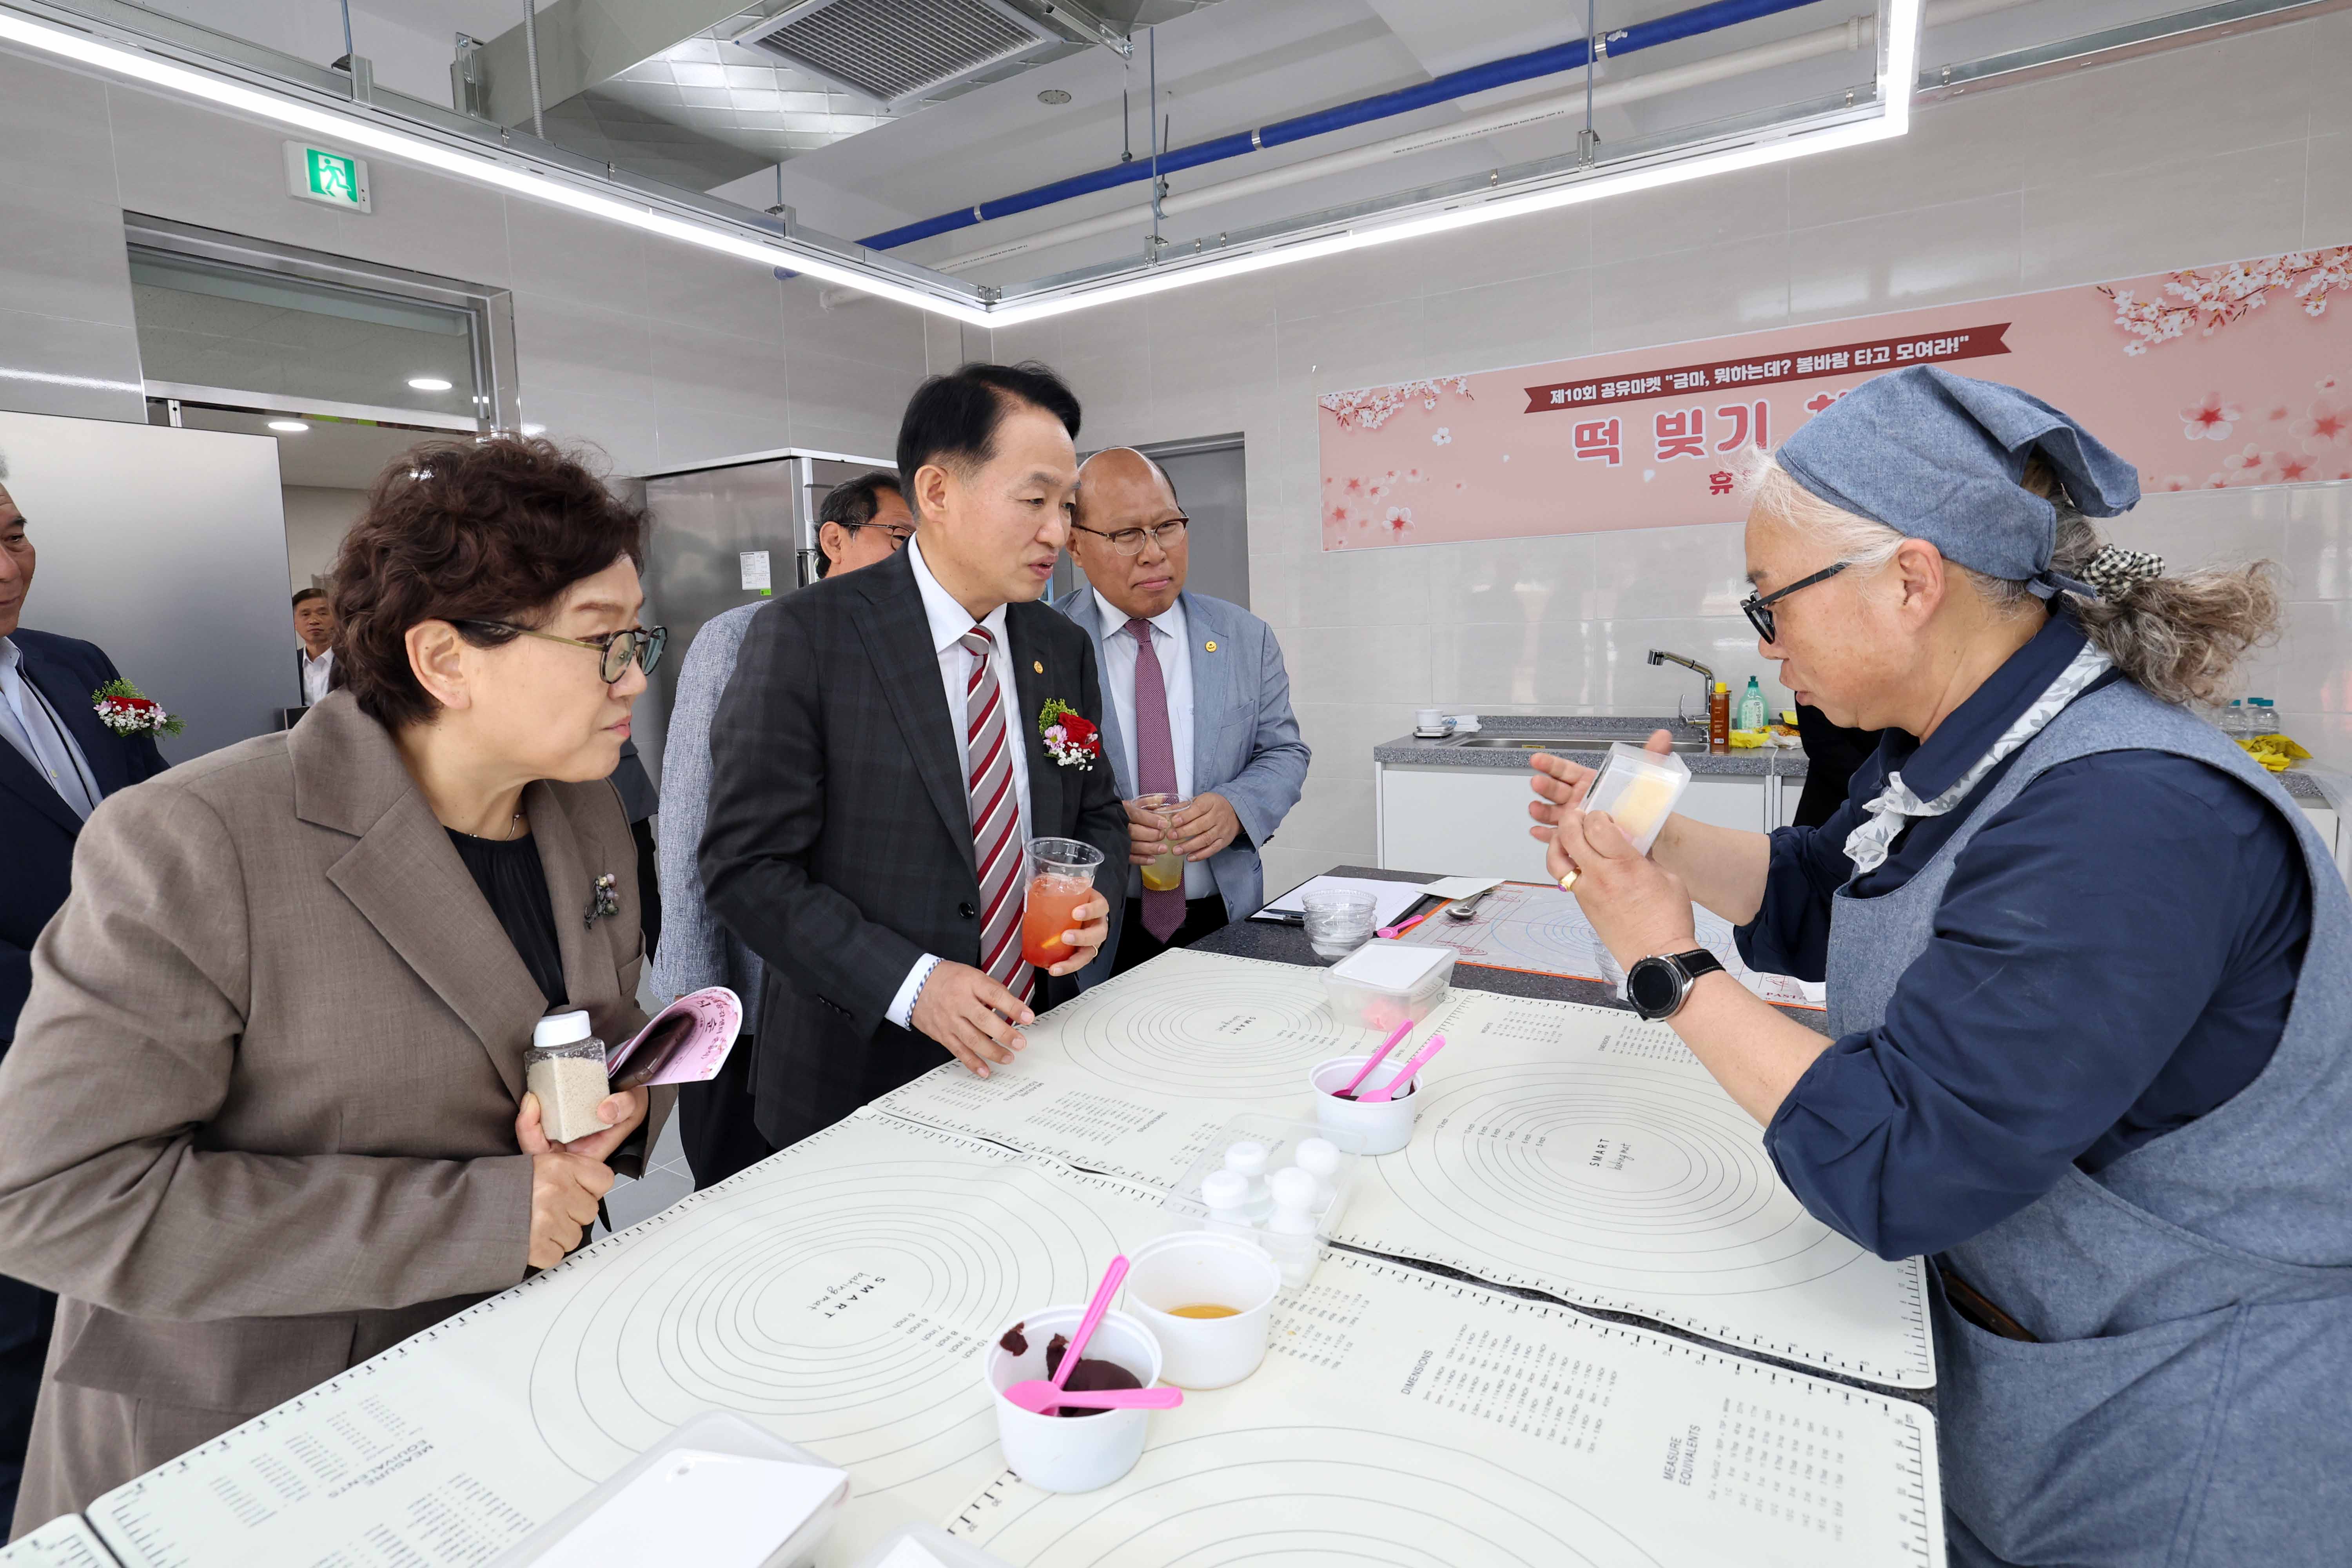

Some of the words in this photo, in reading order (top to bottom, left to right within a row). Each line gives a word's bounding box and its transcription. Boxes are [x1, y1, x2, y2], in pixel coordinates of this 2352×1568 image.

[1550, 384, 1597, 405] 제10회
[1601, 376, 1661, 399] 공유마켓
[1665, 370, 1710, 390] "금마,
[1714, 358, 1791, 384] 뭐하는데?
[1796, 351, 1849, 374] 봄바람
[1854, 346, 1891, 366] 타고
[1896, 334, 1969, 361] 모여라!"
[1573, 416, 1622, 466] 떡
[1654, 399, 1770, 463] 빚기
[1230, 1016, 1256, 1034] SMART
[1003, 1081, 1038, 1102] EQUIVALENTS
[1020, 1082, 1044, 1097] MEASURE
[1137, 1112, 1167, 1132] DIMENSIONS
[1589, 1138, 1610, 1167] SMART
[827, 1272, 870, 1295] baking
[807, 1296, 830, 1311] mat
[824, 1276, 886, 1318] SMART
[893, 1317, 907, 1328] inch
[906, 1323, 921, 1334] inch
[922, 1330, 937, 1341] inch
[935, 1336, 950, 1347] inch
[977, 1339, 988, 1347] 10
[949, 1341, 964, 1353] inch
[962, 1346, 978, 1359] inch
[1401, 1349, 1434, 1395] DIMENSIONS
[1662, 1436, 1682, 1481] MEASURE
[1679, 1424, 1701, 1486] EQUIVALENTS
[327, 1439, 427, 1499] EQUIVALENTS
[365, 1444, 434, 1487] MEASURE
